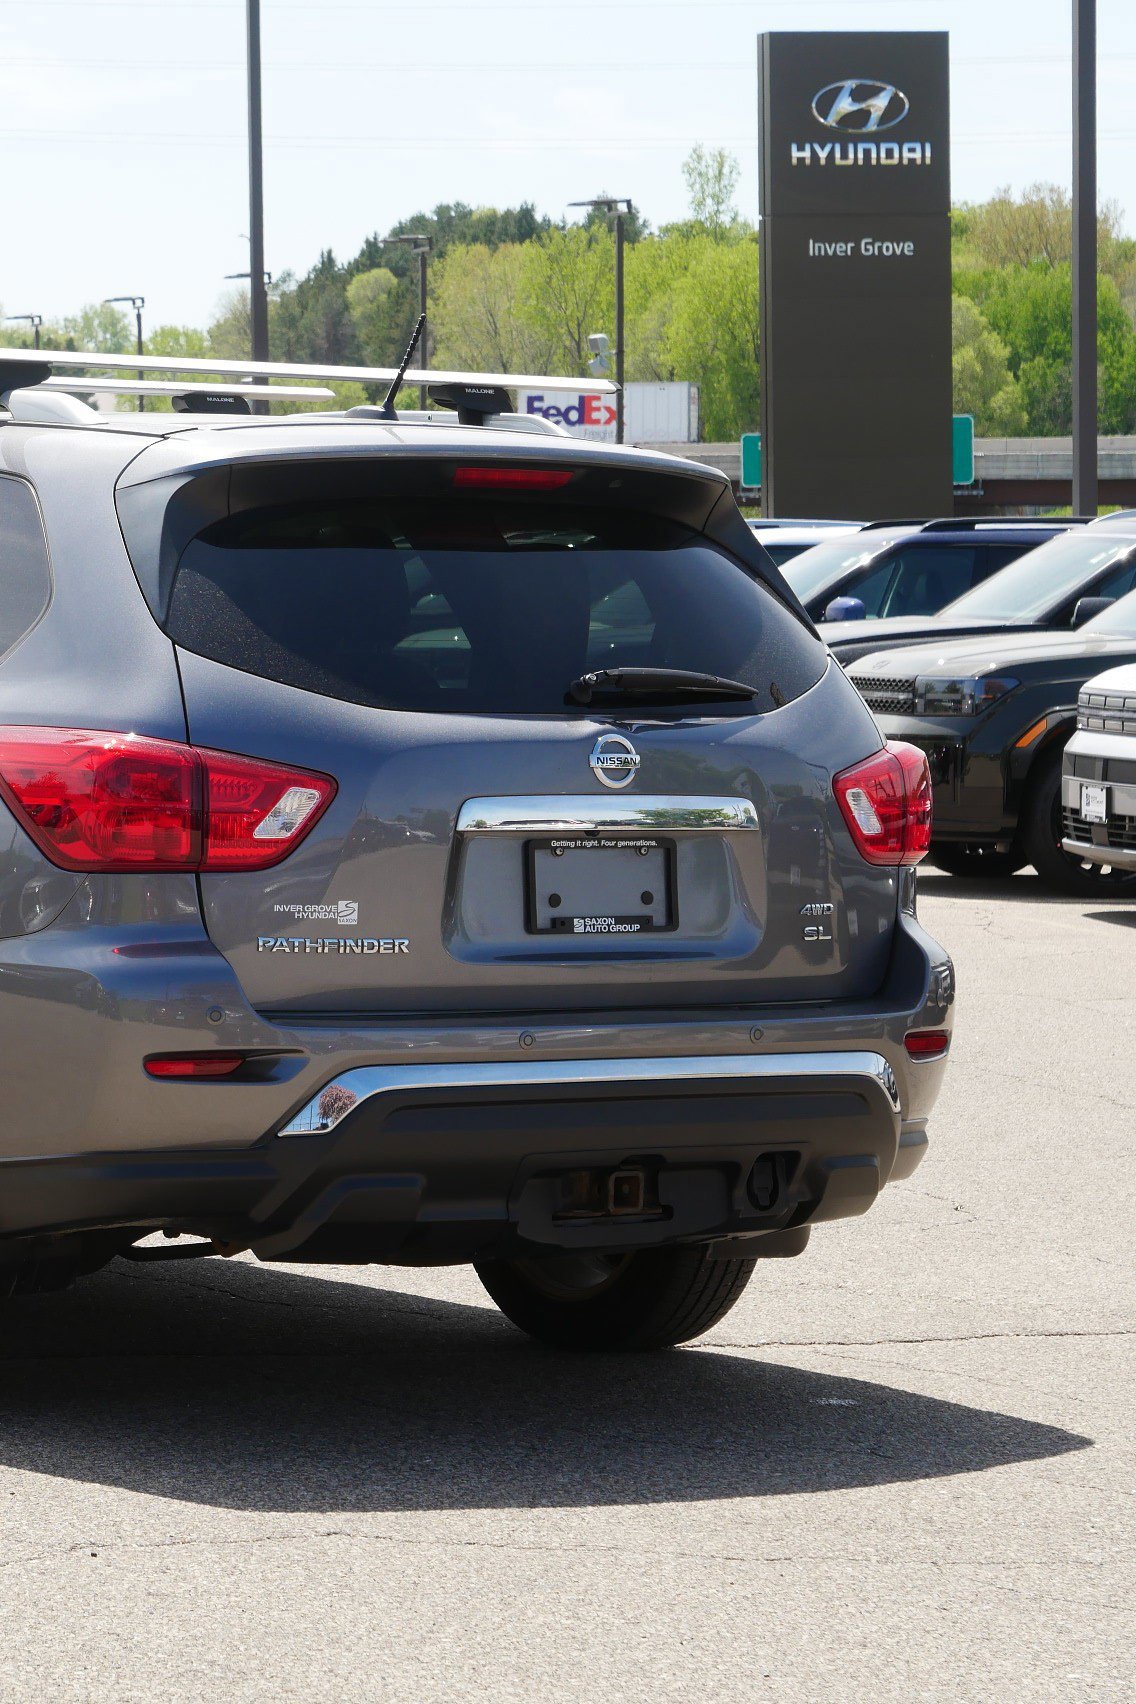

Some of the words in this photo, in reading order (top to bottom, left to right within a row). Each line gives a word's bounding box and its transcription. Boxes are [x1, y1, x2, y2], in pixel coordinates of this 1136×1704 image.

[791, 142, 932, 166] HYUNDAI
[809, 238, 855, 257] Inver
[861, 238, 915, 257] Grove
[465, 387, 495, 395] MALONE
[526, 395, 627, 426] FedEx
[596, 756, 637, 765] NISSAN
[551, 840, 575, 848] Getting
[582, 840, 600, 848] right.
[617, 840, 658, 848] generations.
[274, 904, 303, 912] INVER
[304, 904, 338, 912] GROVE
[800, 903, 834, 915] 4WD
[295, 911, 338, 919] HYUNDAI
[585, 917, 615, 925] SAXON
[585, 924, 610, 932] AUTO
[610, 924, 641, 932] GROUP
[804, 926, 832, 941] SL
[257, 936, 410, 954] PATHFINDER
